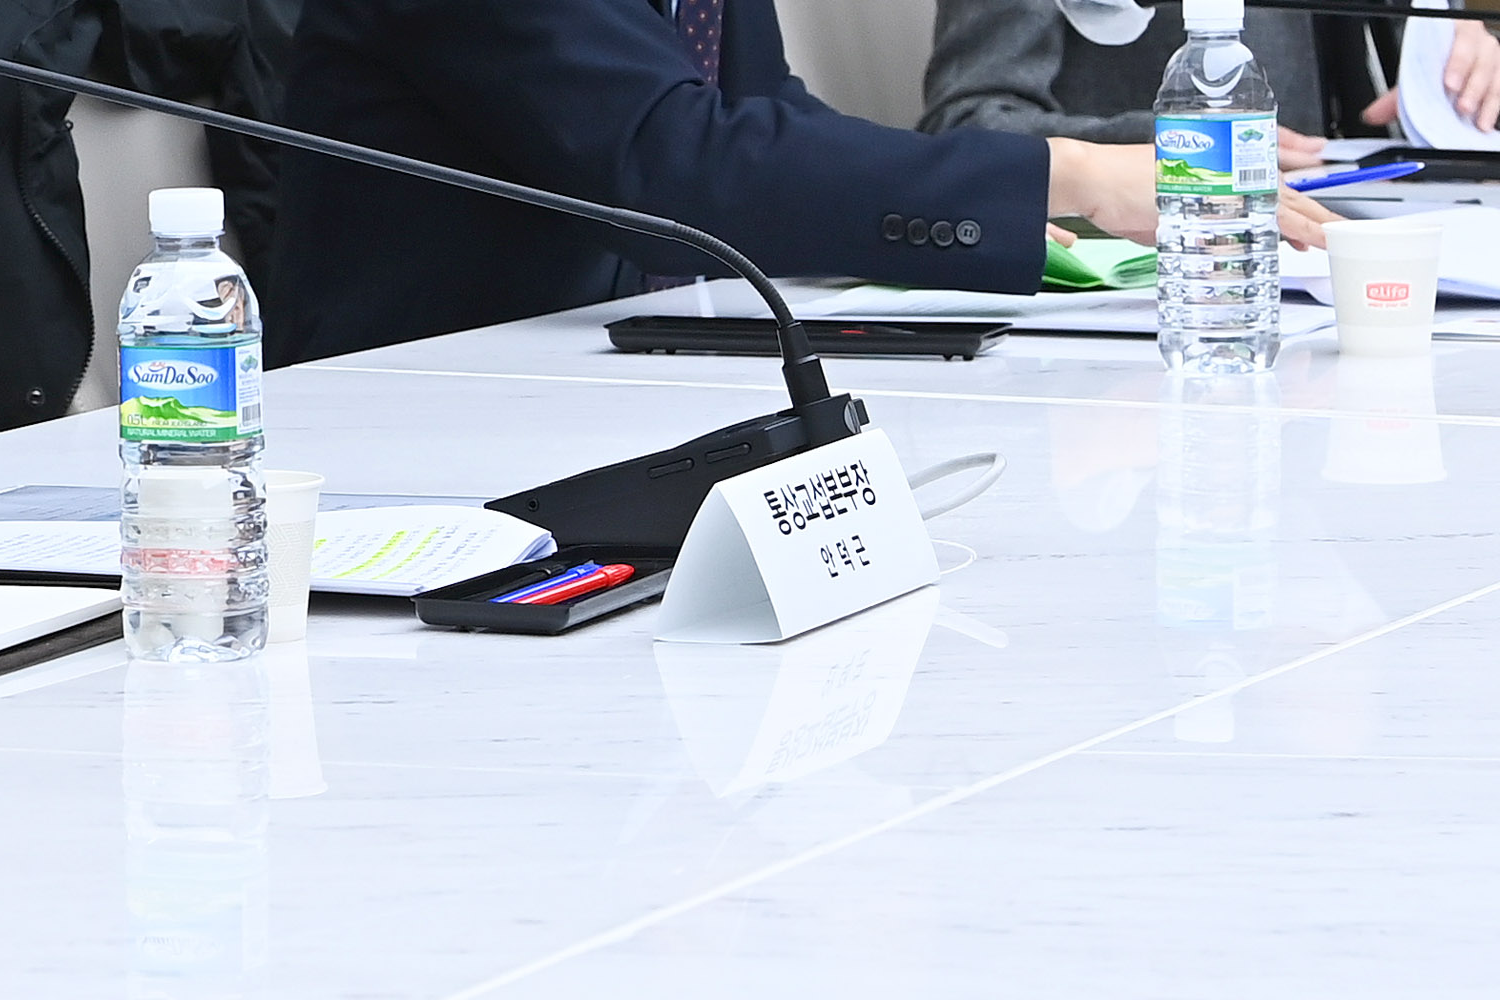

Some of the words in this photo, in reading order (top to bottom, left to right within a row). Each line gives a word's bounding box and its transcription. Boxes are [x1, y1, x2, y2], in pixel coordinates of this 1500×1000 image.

[1158, 133, 1211, 150] SamDaSoo
[133, 364, 215, 386] SamDaSoo
[763, 459, 877, 536] 통상교섭본부장
